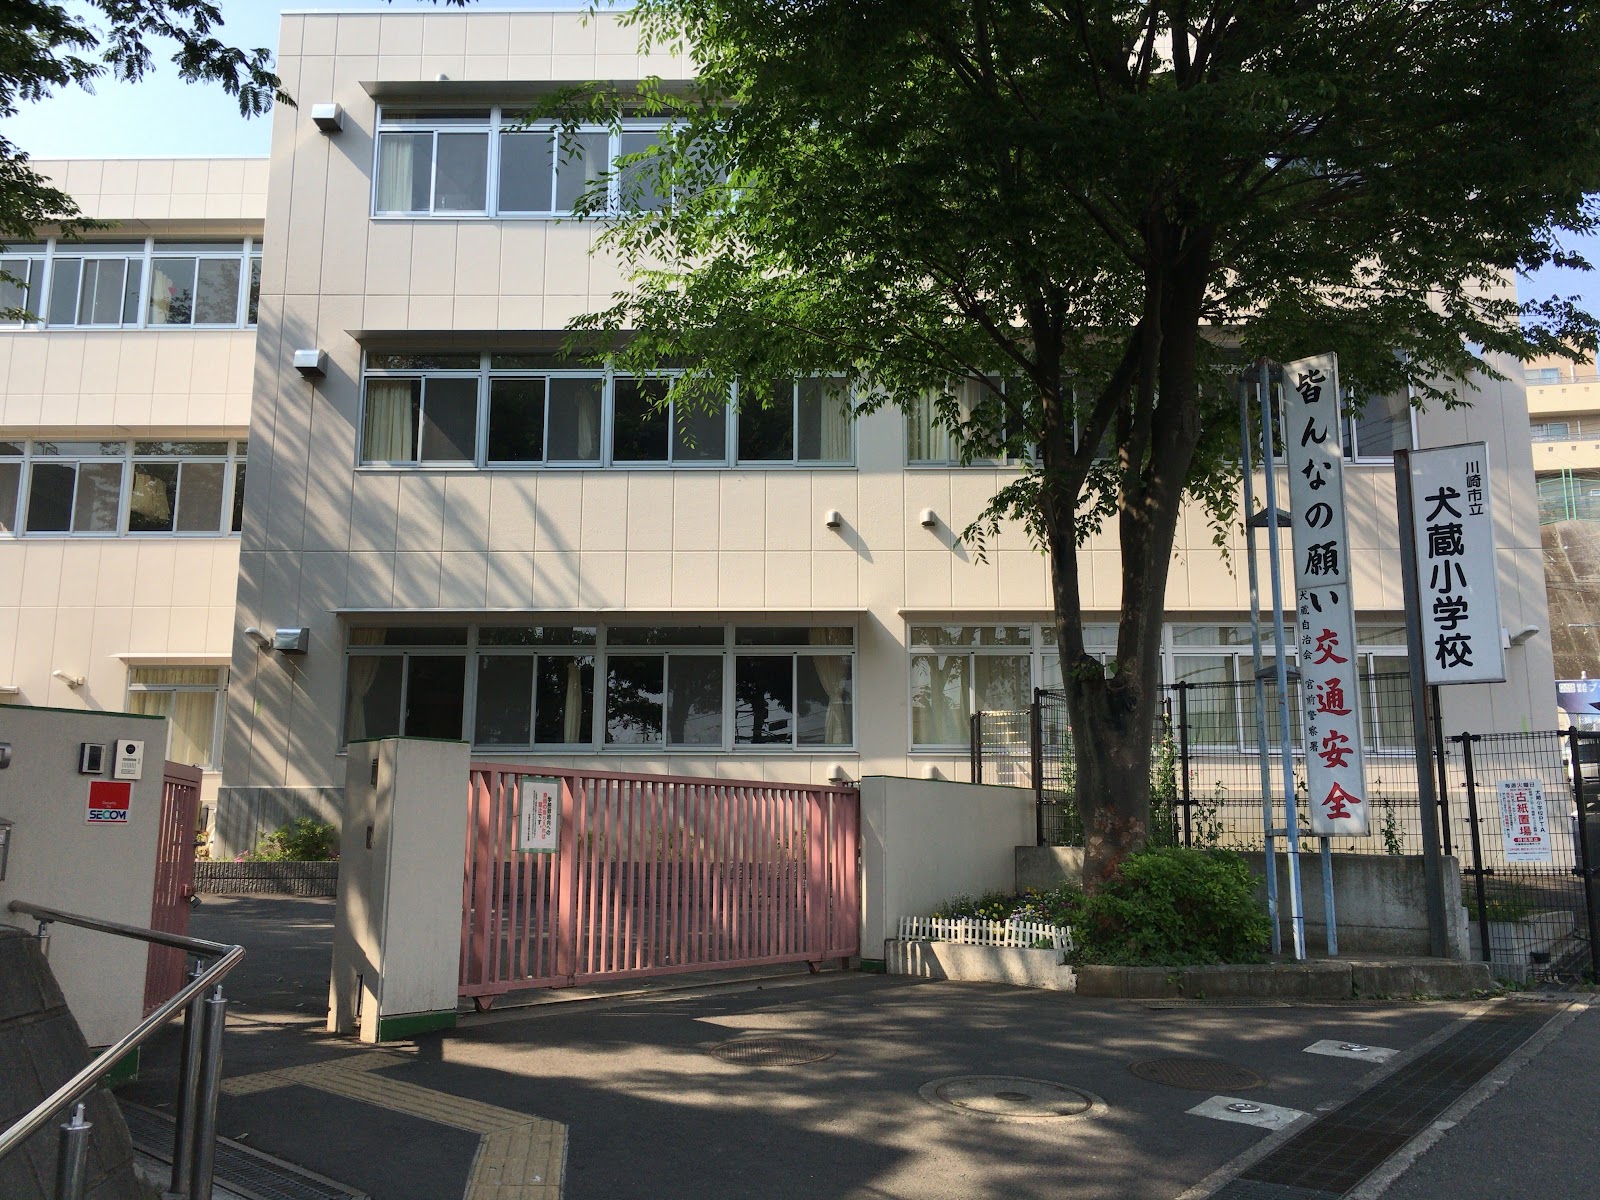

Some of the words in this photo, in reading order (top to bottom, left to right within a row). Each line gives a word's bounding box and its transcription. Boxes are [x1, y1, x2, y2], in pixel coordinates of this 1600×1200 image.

[1466, 460, 1484, 516] 川崎市立
[1425, 486, 1474, 669] 犬蔵小学校
[1299, 590, 1313, 661] 犬蔵自治会
[1304, 678, 1319, 752] 宮前警察署
[89, 810, 127, 820] SECOM
[1515, 792, 1531, 836] 古紙置場
